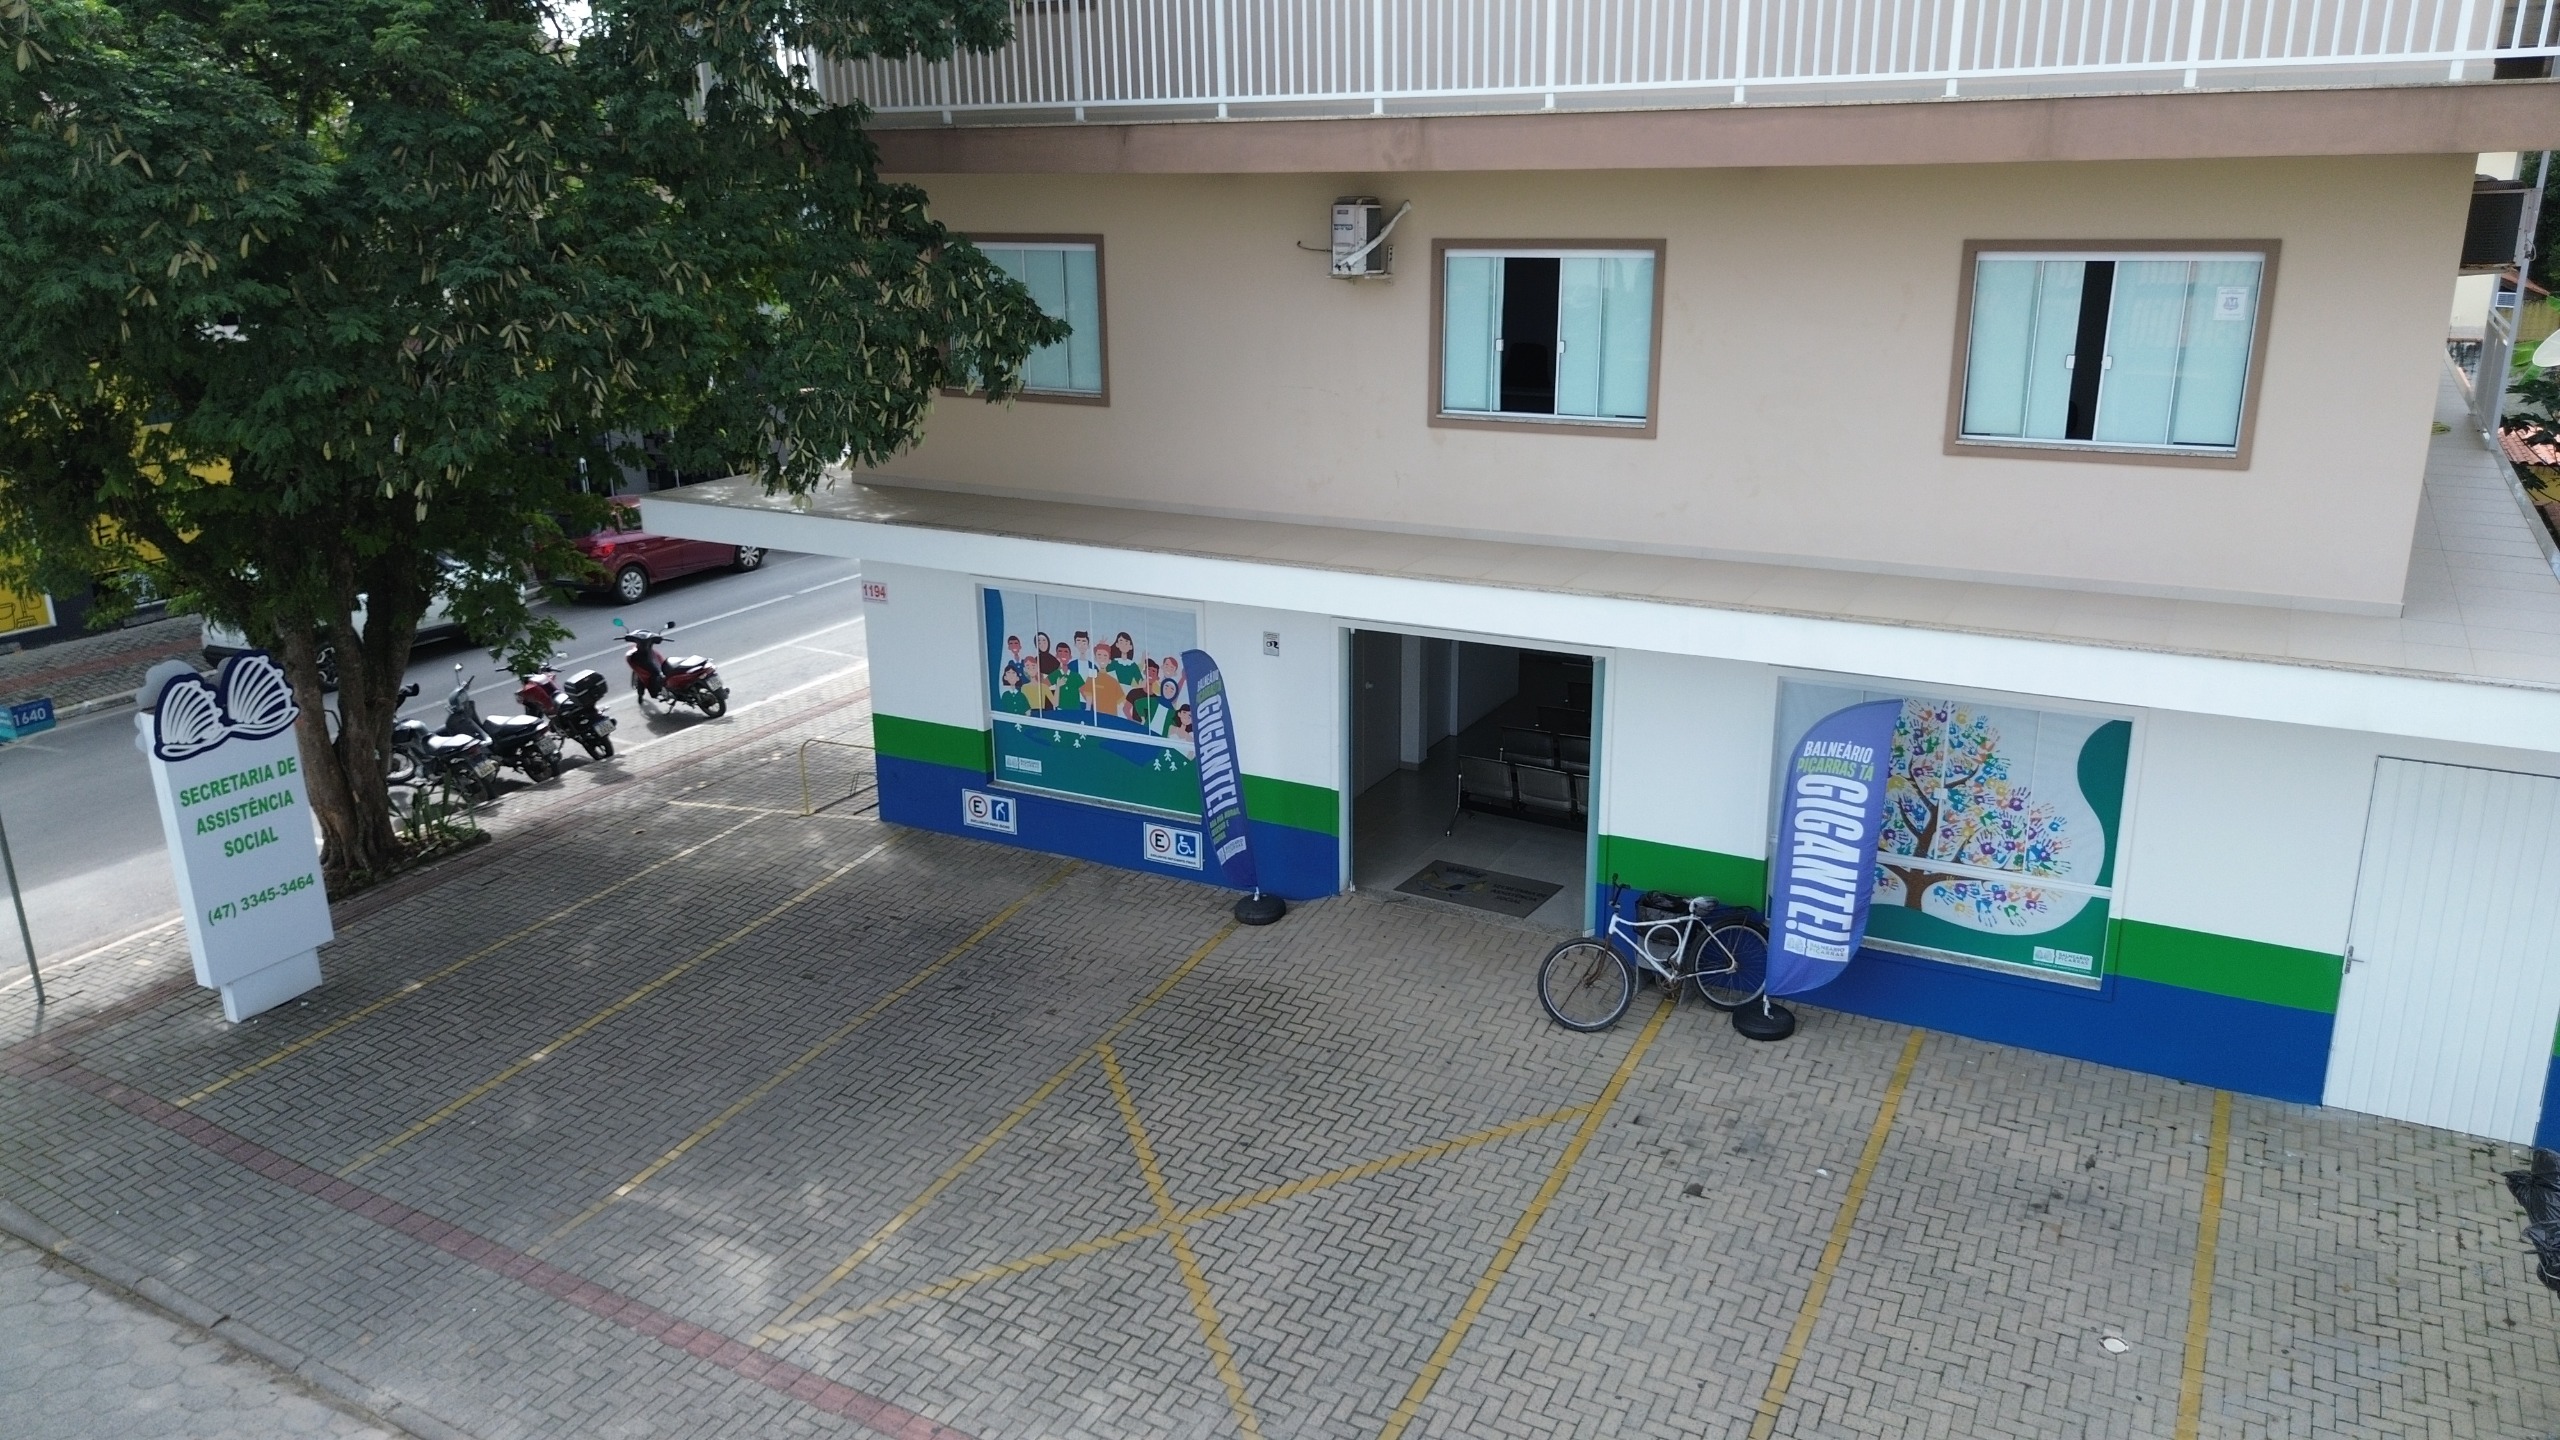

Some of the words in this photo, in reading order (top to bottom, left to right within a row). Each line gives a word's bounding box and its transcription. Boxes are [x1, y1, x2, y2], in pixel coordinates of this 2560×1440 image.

[863, 584, 886, 598] 1194
[13, 708, 47, 727] 1640
[1196, 693, 1238, 818] GIGANTE!
[1803, 741, 1873, 764] BALNEÁRIO
[180, 764, 275, 807] SECRETARIA
[277, 756, 298, 777] DE
[1796, 757, 1857, 778] PIÇARRAS
[1859, 762, 1875, 781] TÁ
[196, 789, 295, 835] ASSISTÊNCIA
[973, 799, 983, 814] E
[224, 826, 279, 857] SOCIAL
[1155, 833, 1165, 848] E
[1785, 774, 1869, 943] GIGANTE!
[208, 902, 237, 926] (47)
[240, 872, 315, 911] 3345-3464
